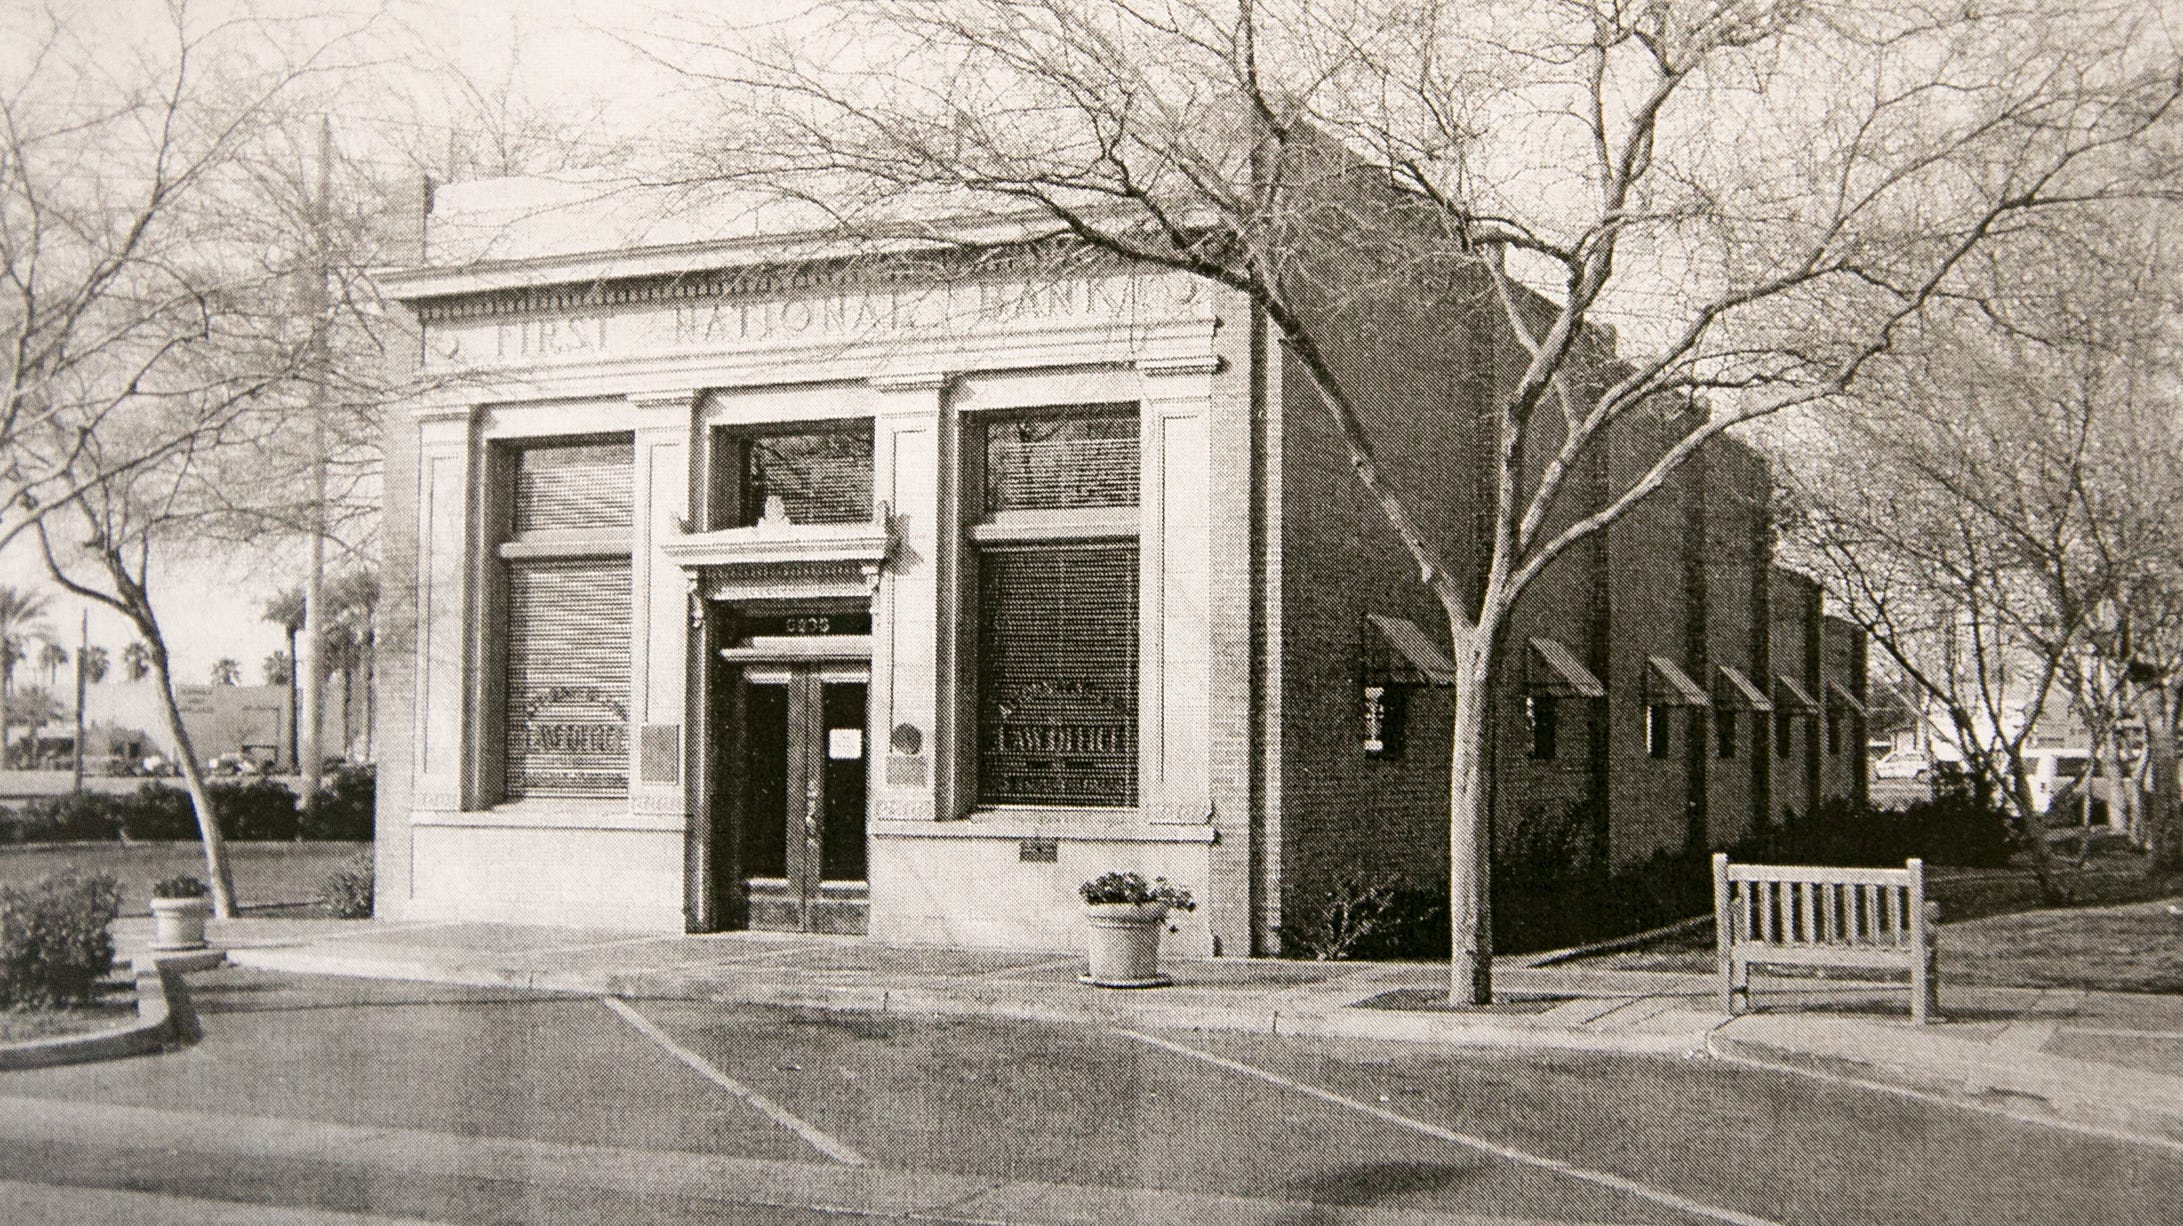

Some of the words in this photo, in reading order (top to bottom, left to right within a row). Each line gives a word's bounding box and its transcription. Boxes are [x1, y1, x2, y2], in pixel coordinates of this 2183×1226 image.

[497, 313, 609, 360] FIRST
[674, 289, 914, 346] NATIONAL
[979, 276, 1127, 323] BANK
